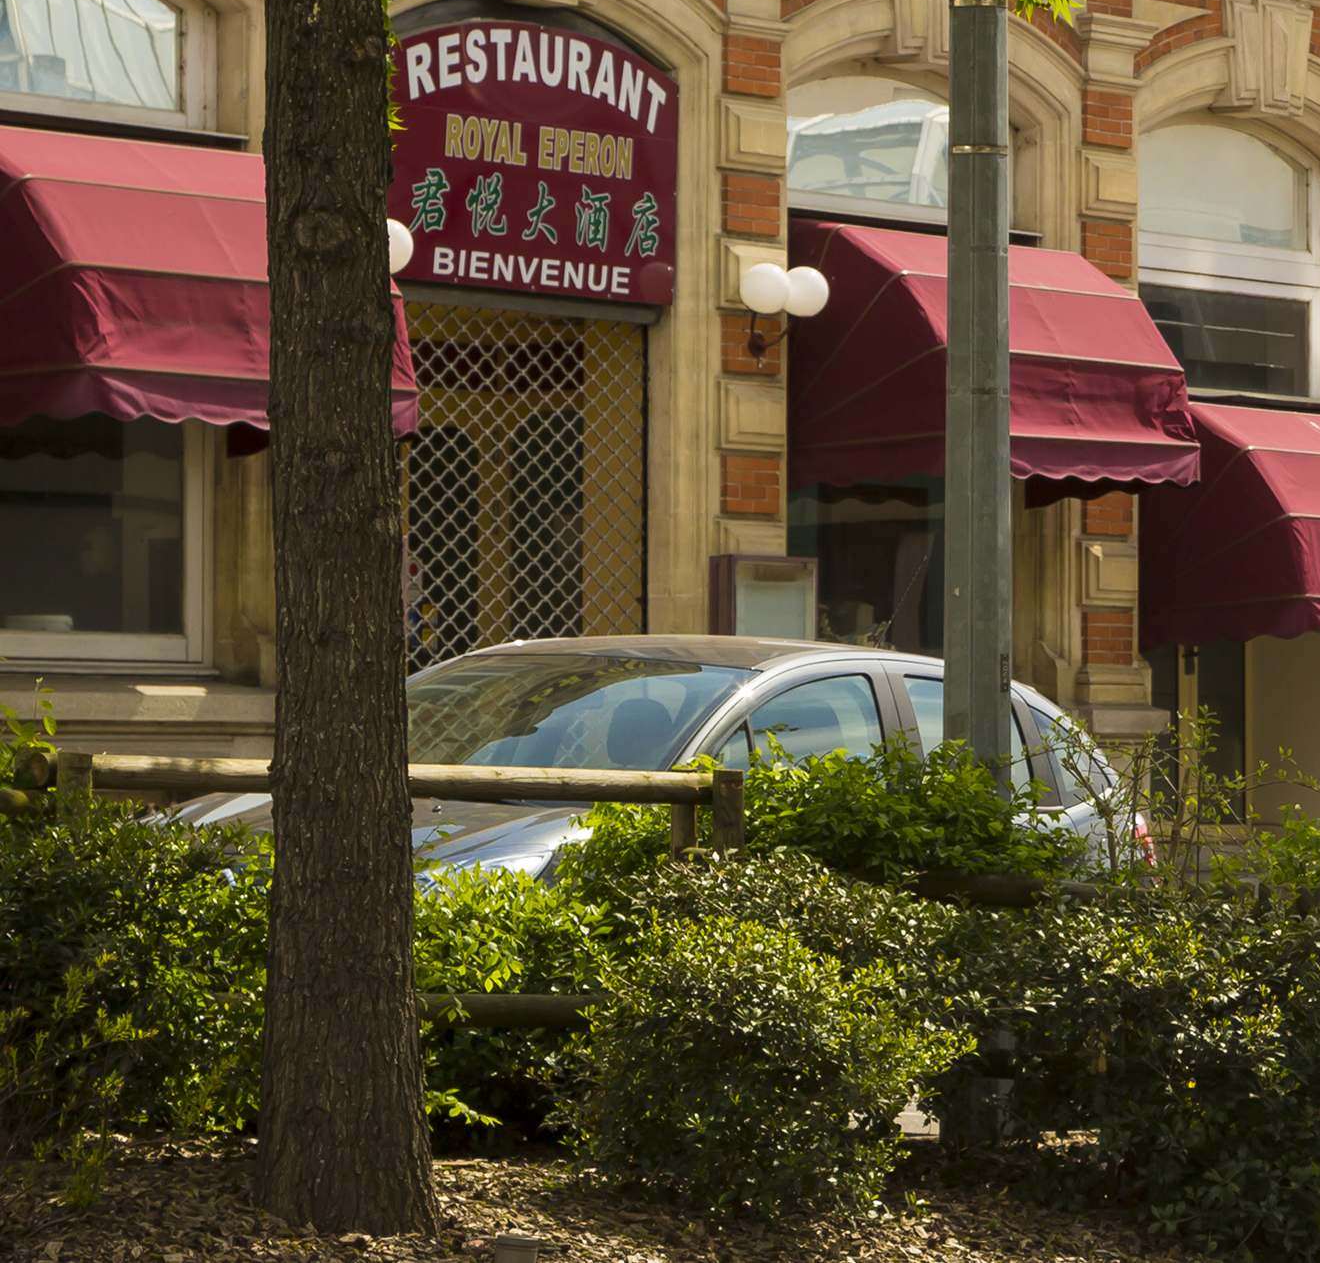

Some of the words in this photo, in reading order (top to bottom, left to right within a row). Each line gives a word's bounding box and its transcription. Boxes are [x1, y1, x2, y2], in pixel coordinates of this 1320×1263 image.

[405, 28, 667, 134] RESTAURANT
[444, 113, 527, 166] ROYAL
[537, 124, 635, 180] EPERON
[432, 247, 632, 295] BIENVENUE
